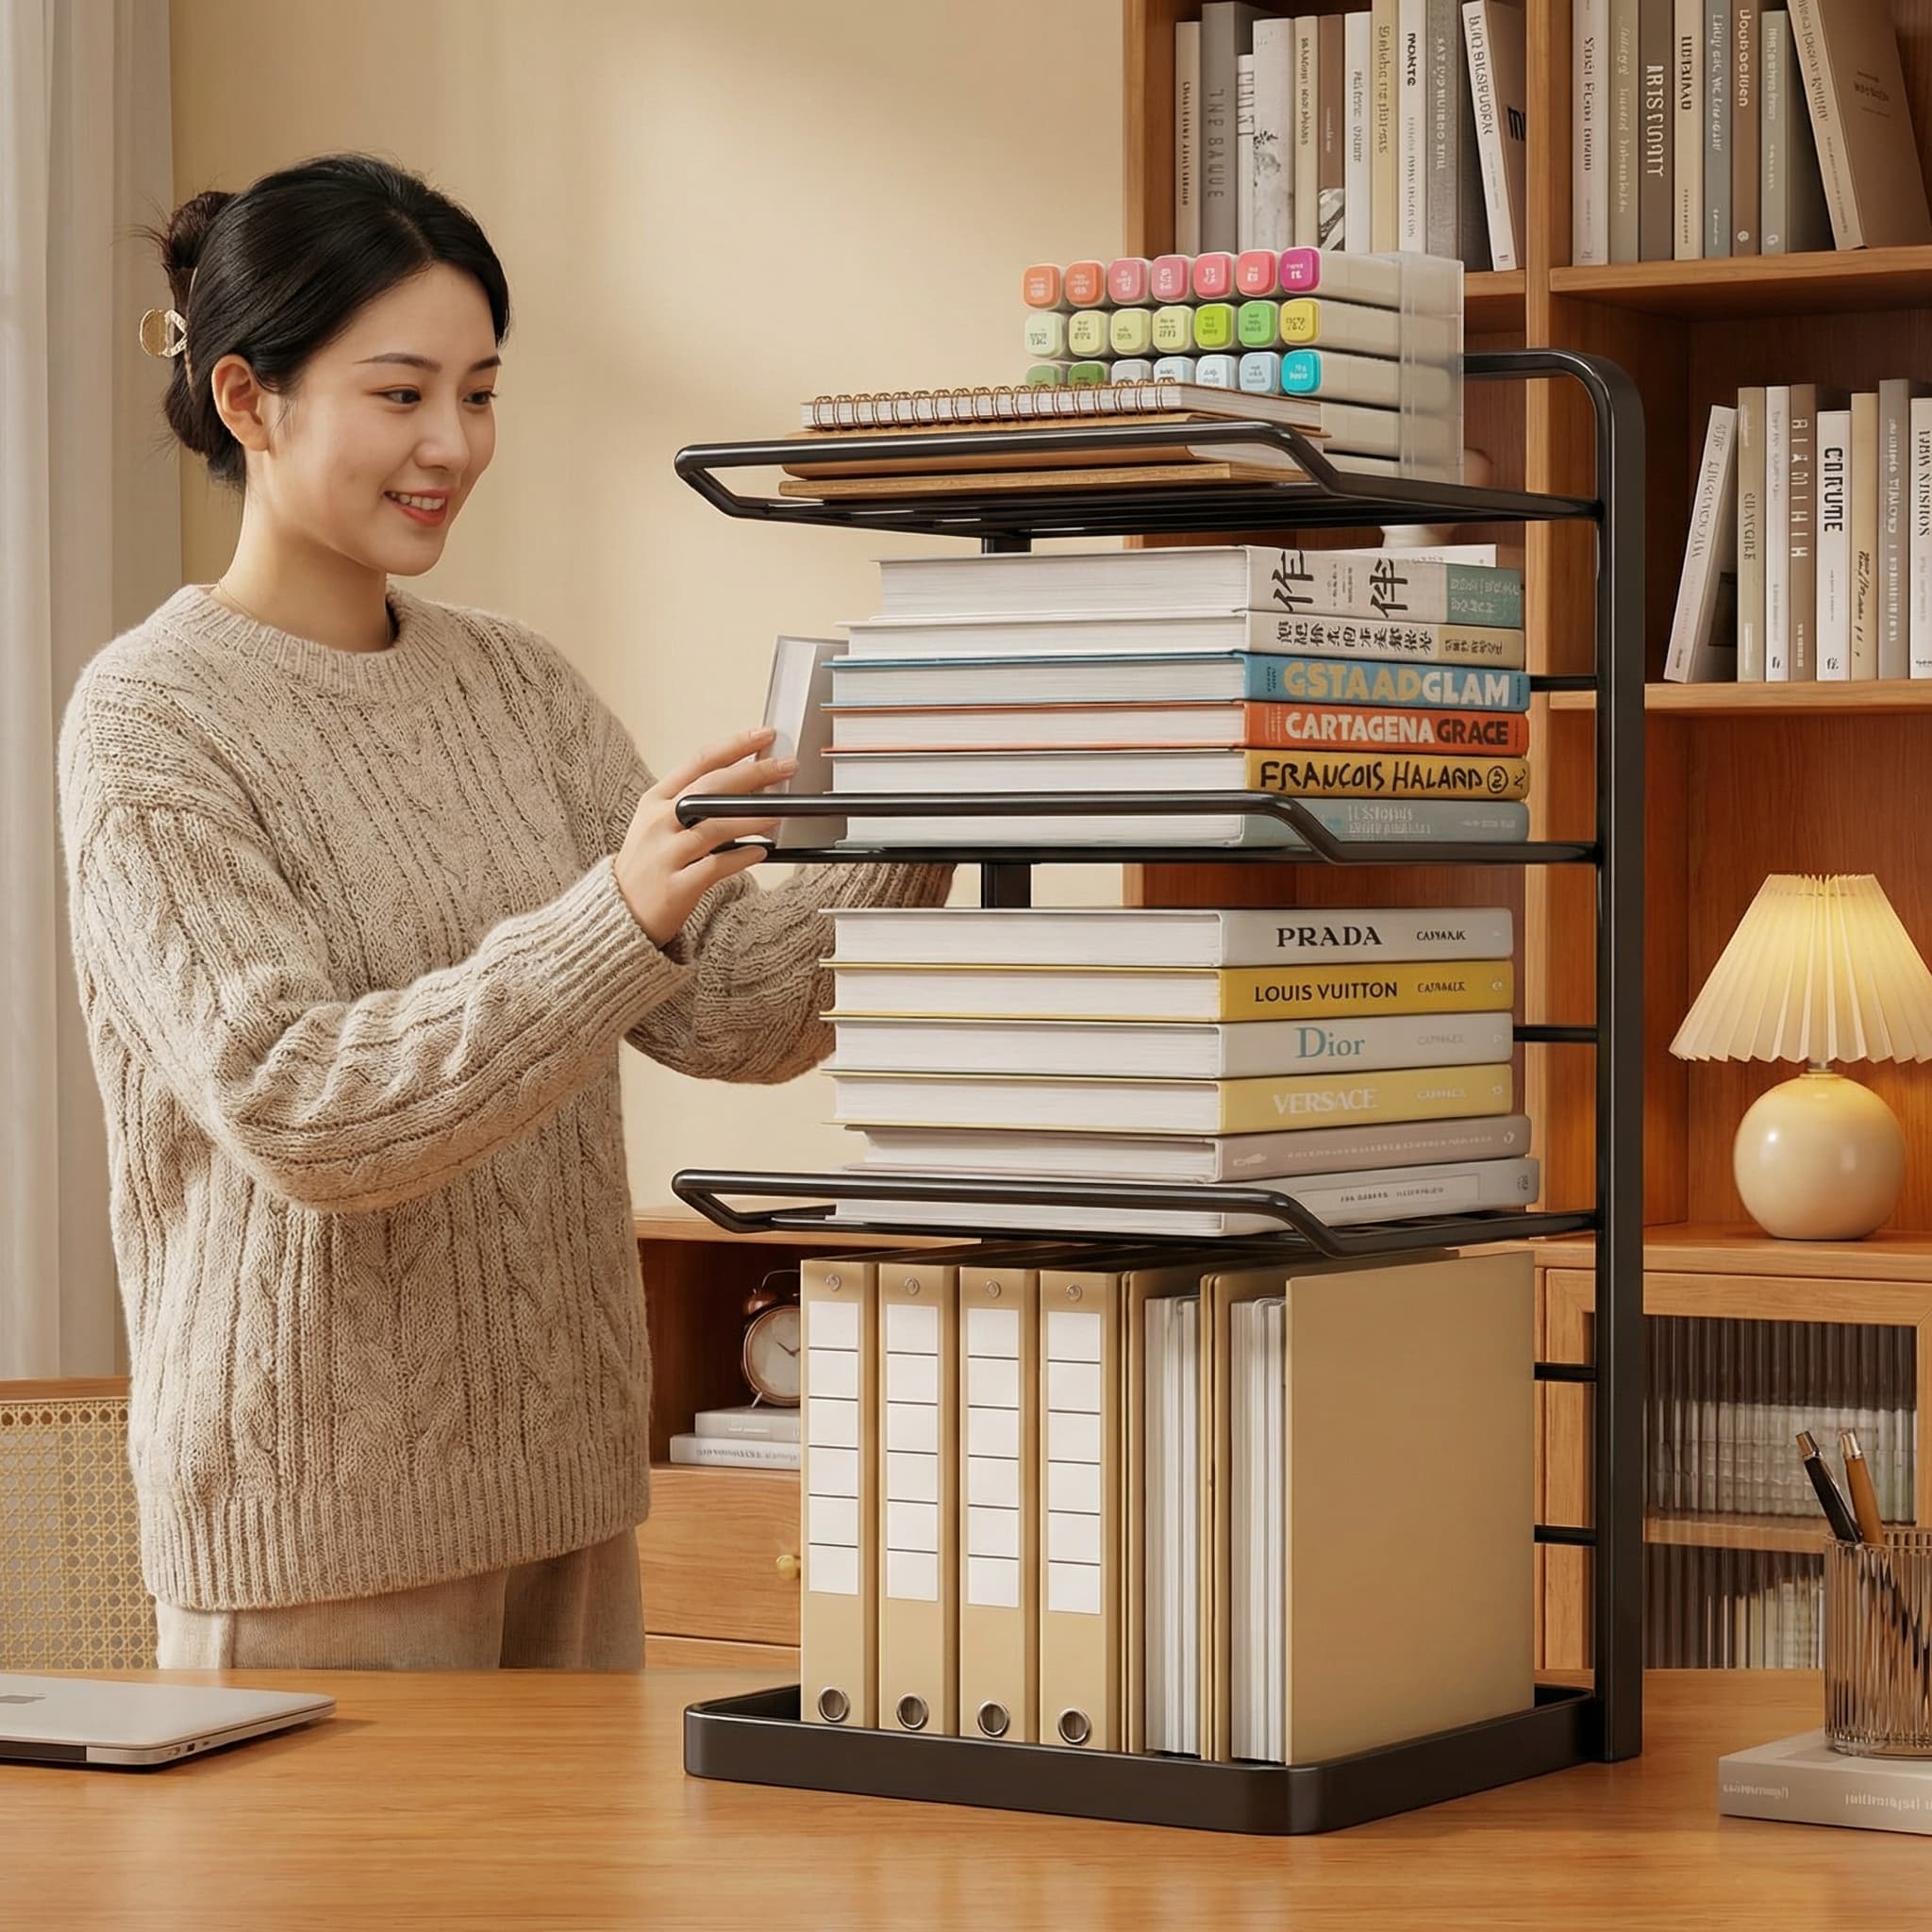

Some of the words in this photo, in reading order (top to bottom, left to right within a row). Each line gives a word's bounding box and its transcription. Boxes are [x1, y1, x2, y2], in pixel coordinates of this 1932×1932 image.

[1283, 661, 1421, 702] GSTAAD
[1421, 672, 1509, 707] GLAM
[1285, 712, 1435, 743] CARTAGENA
[1436, 718, 1509, 745] GRACE
[1275, 925, 1383, 947] PRADA
[1255, 985, 1312, 1003] LOUIS
[1317, 981, 1398, 1000] VUITTON
[1294, 1026, 1365, 1058] Dior
[1273, 1088, 1377, 1115] VERSACE
